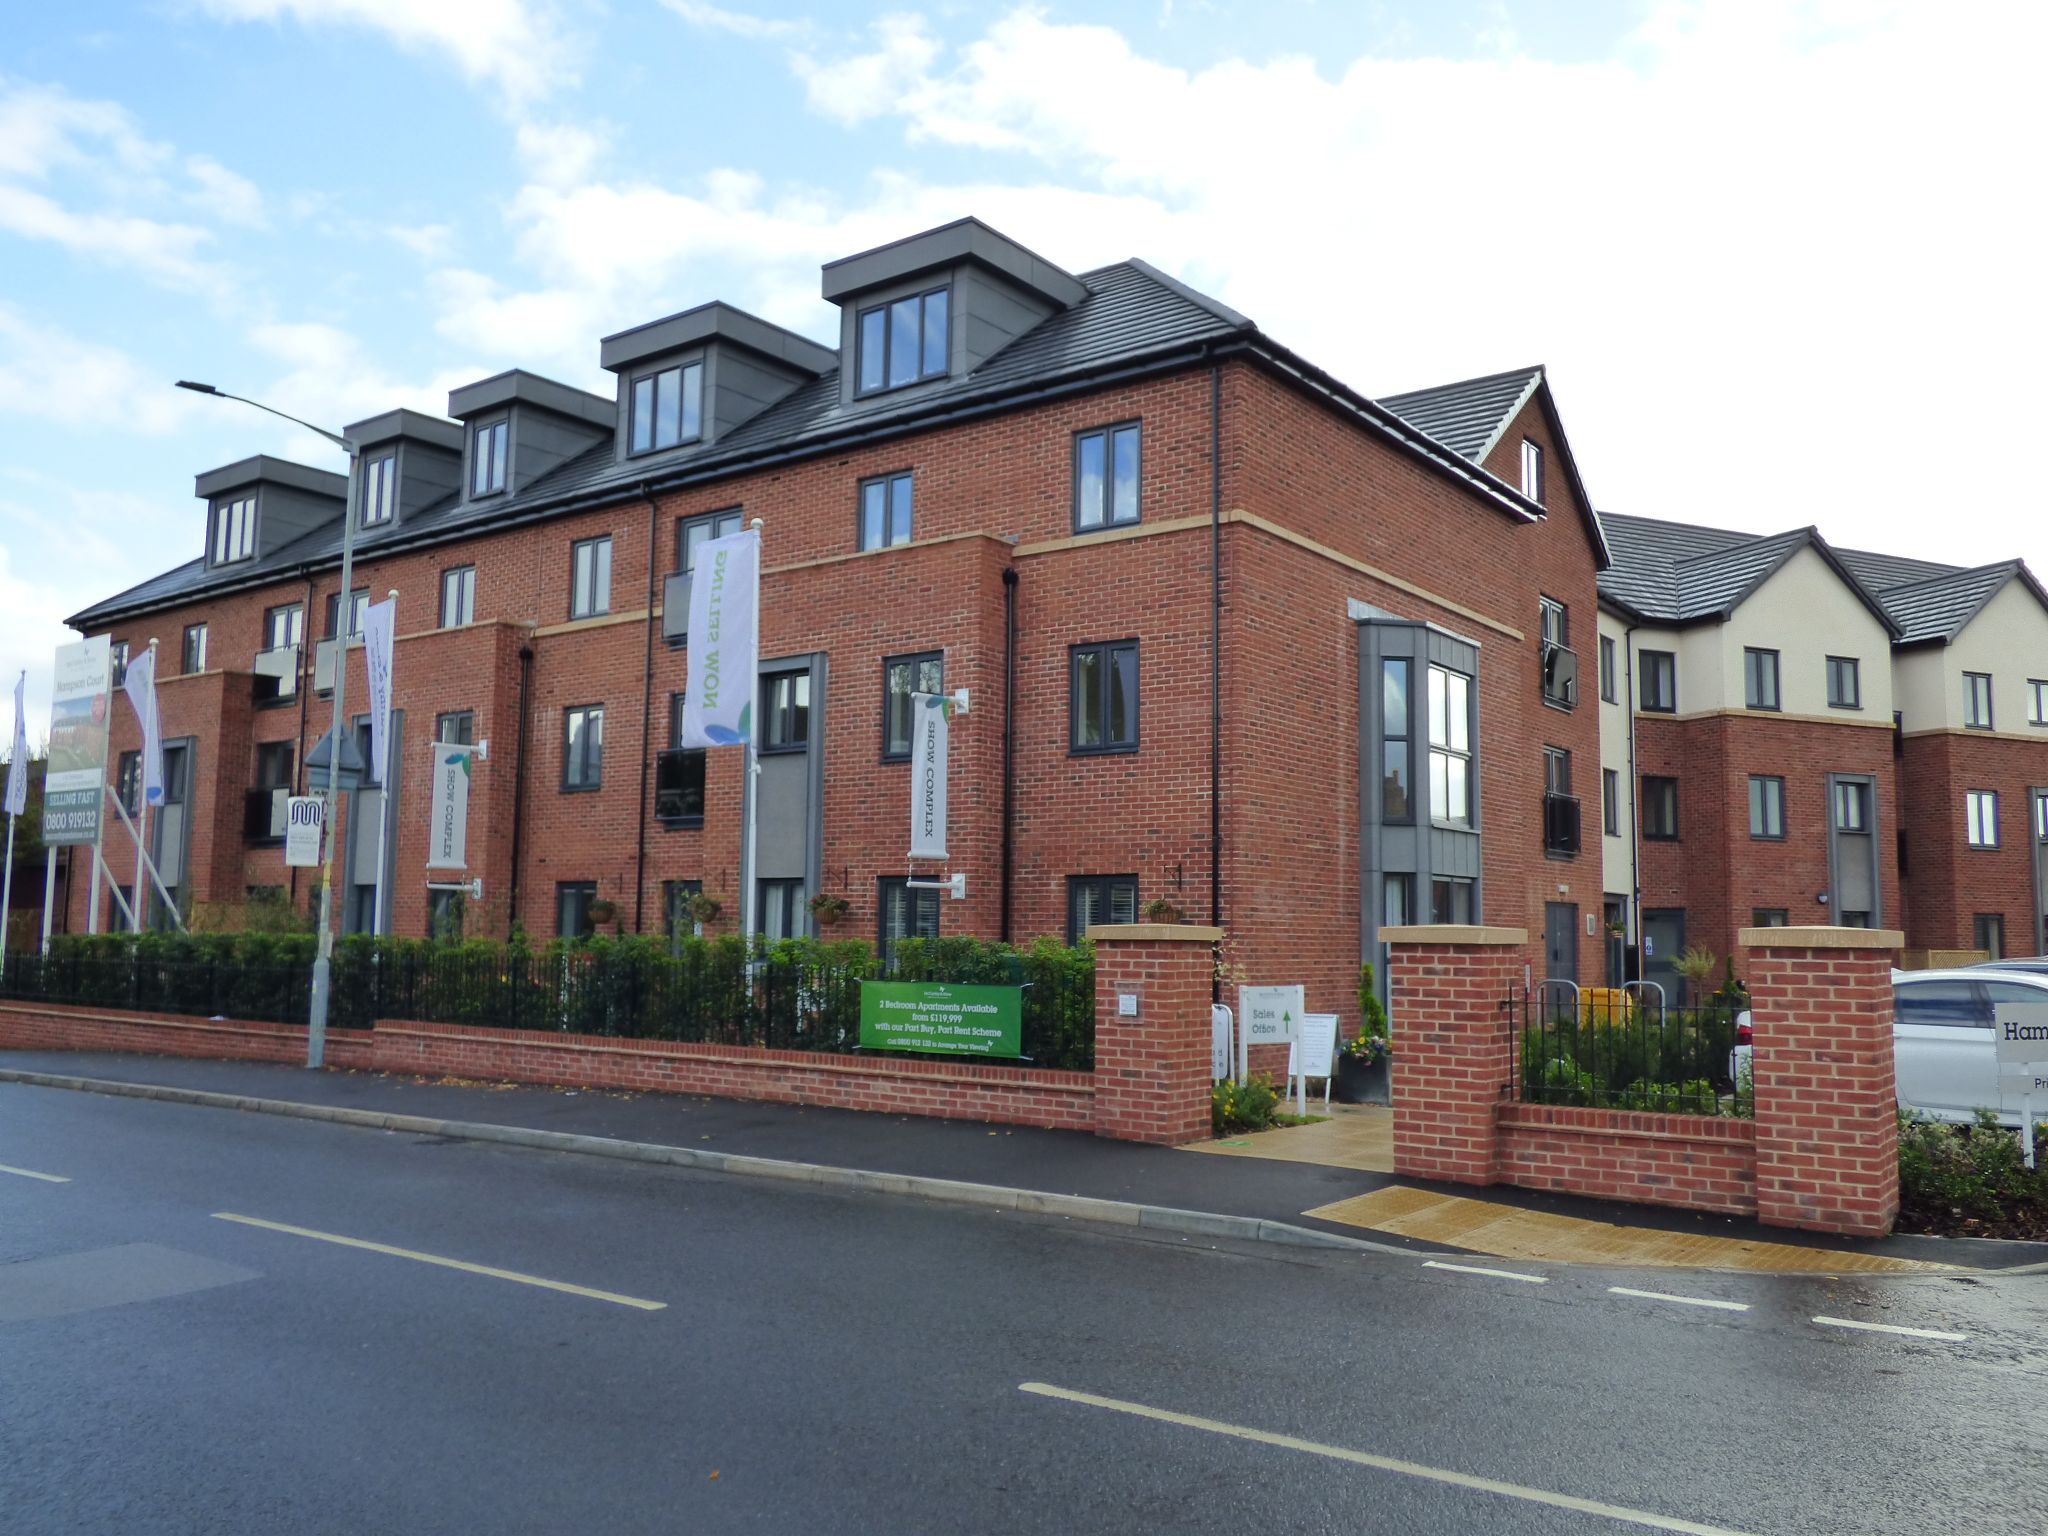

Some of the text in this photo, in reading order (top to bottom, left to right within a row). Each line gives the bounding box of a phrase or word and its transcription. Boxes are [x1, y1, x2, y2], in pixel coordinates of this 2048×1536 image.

[925, 720, 936, 838] SHOW COMPLEX
[49, 791, 95, 807] SELLING FAST
[46, 810, 96, 830] 0800 919132
[443, 769, 456, 858] SHOW COMPLEX
[880, 1000, 998, 1014] 2 Bedroom Apartments Available
[1253, 1009, 1276, 1020] Sales
[912, 1013, 929, 1021] from
[875, 1022, 890, 1031] with
[904, 1023, 920, 1033] Part
[937, 1025, 953, 1034] Part
[953, 1026, 971, 1036] Rent
[971, 1026, 1002, 1037] Scheme
[1252, 1024, 1277, 1034] Office
